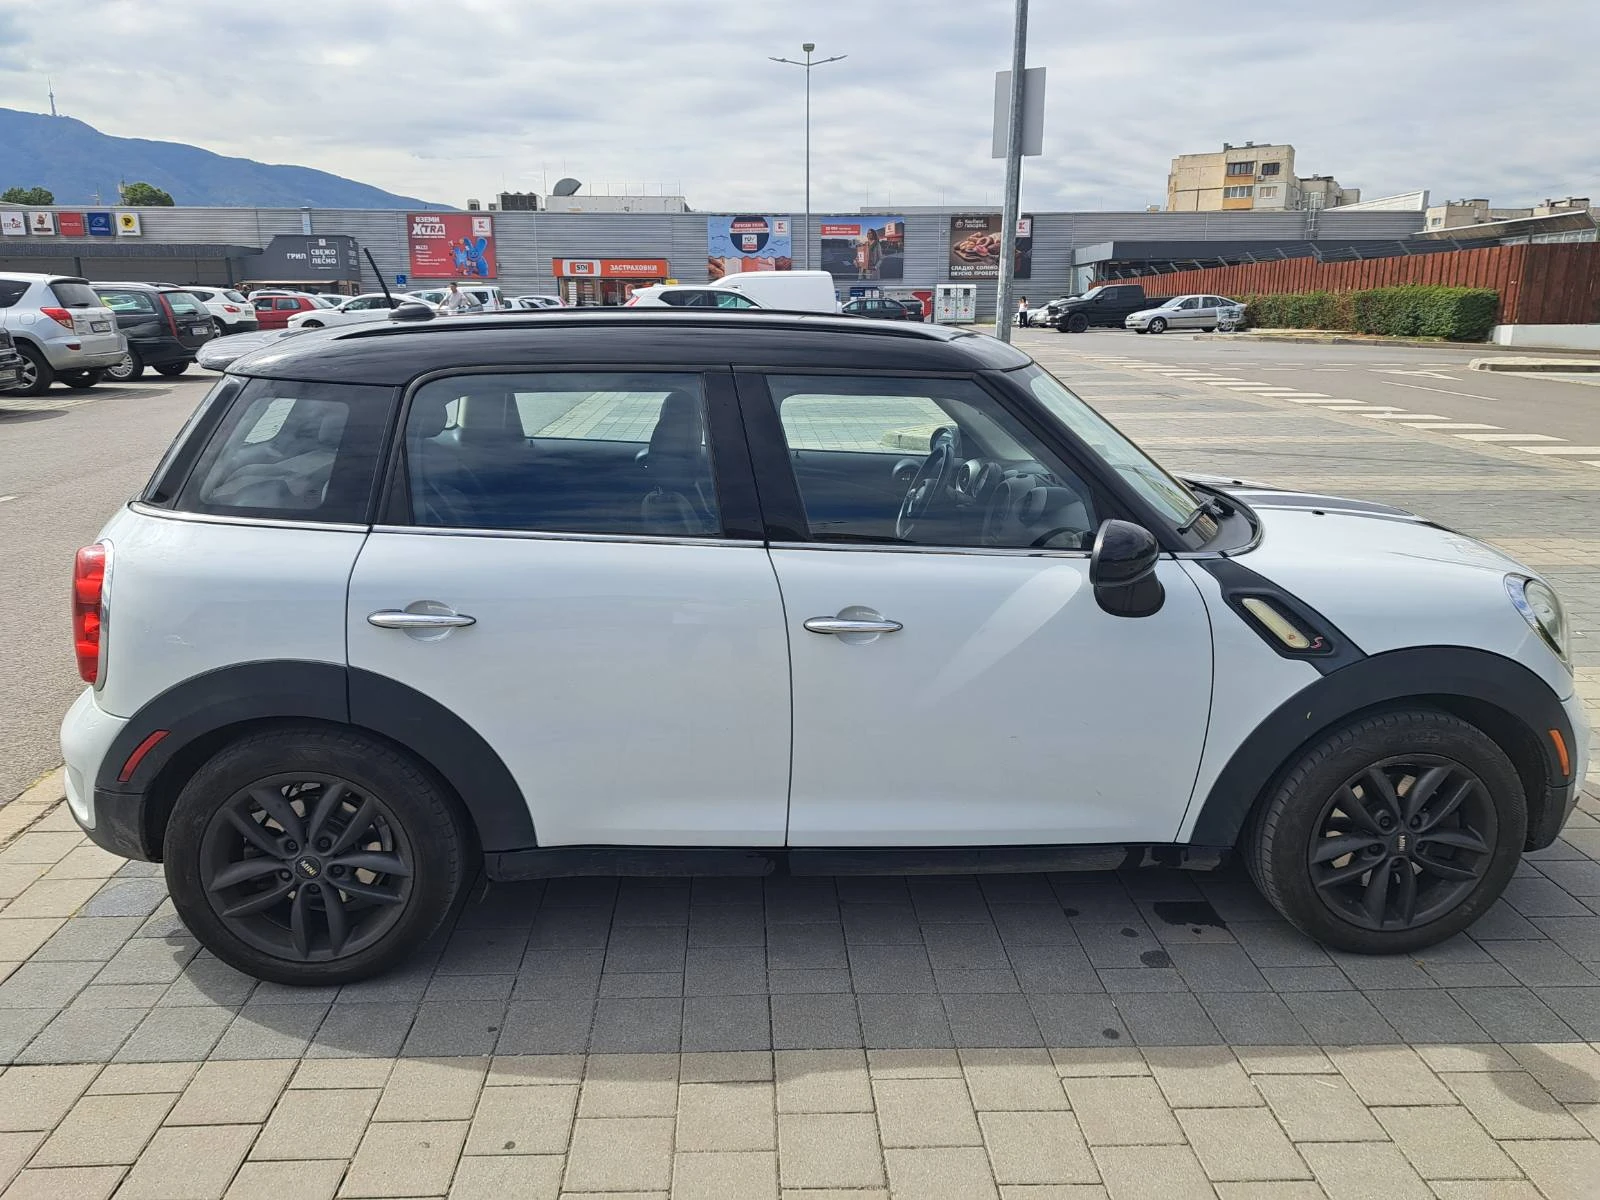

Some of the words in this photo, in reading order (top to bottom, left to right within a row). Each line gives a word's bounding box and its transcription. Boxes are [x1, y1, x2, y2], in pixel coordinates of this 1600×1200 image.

[411, 224, 445, 235] XTRA
[310, 248, 337, 256] СВЕЖО
[300, 860, 317, 876] MINI
